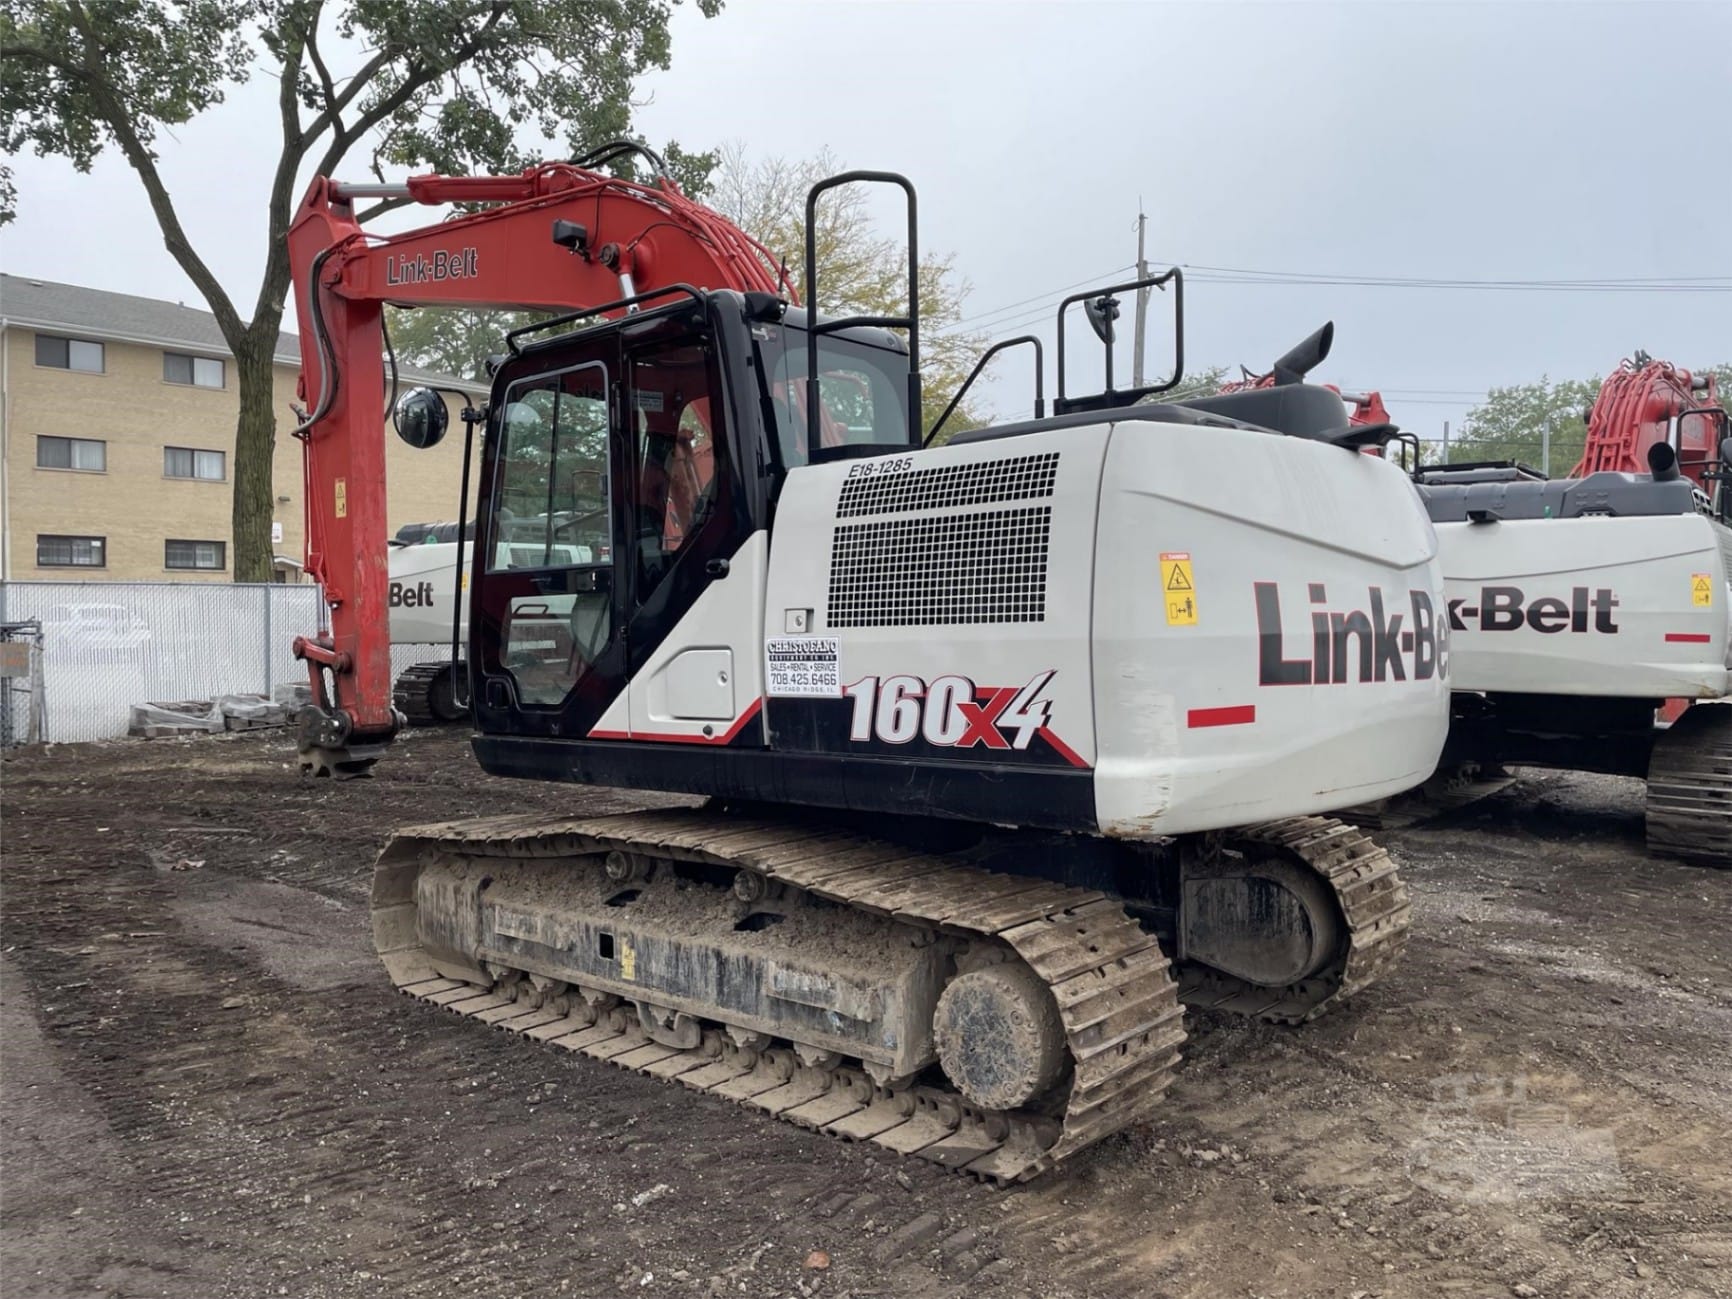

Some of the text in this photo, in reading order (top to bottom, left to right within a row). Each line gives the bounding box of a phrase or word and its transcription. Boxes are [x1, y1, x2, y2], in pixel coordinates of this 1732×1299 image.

[387, 247, 478, 286] Link-Belt
[848, 457, 914, 478] E18-1285
[389, 581, 434, 608] Belt
[1254, 582, 1450, 686] Link-Be
[770, 673, 836, 685] 708.425.6466
[813, 663, 836, 671] SERVICE
